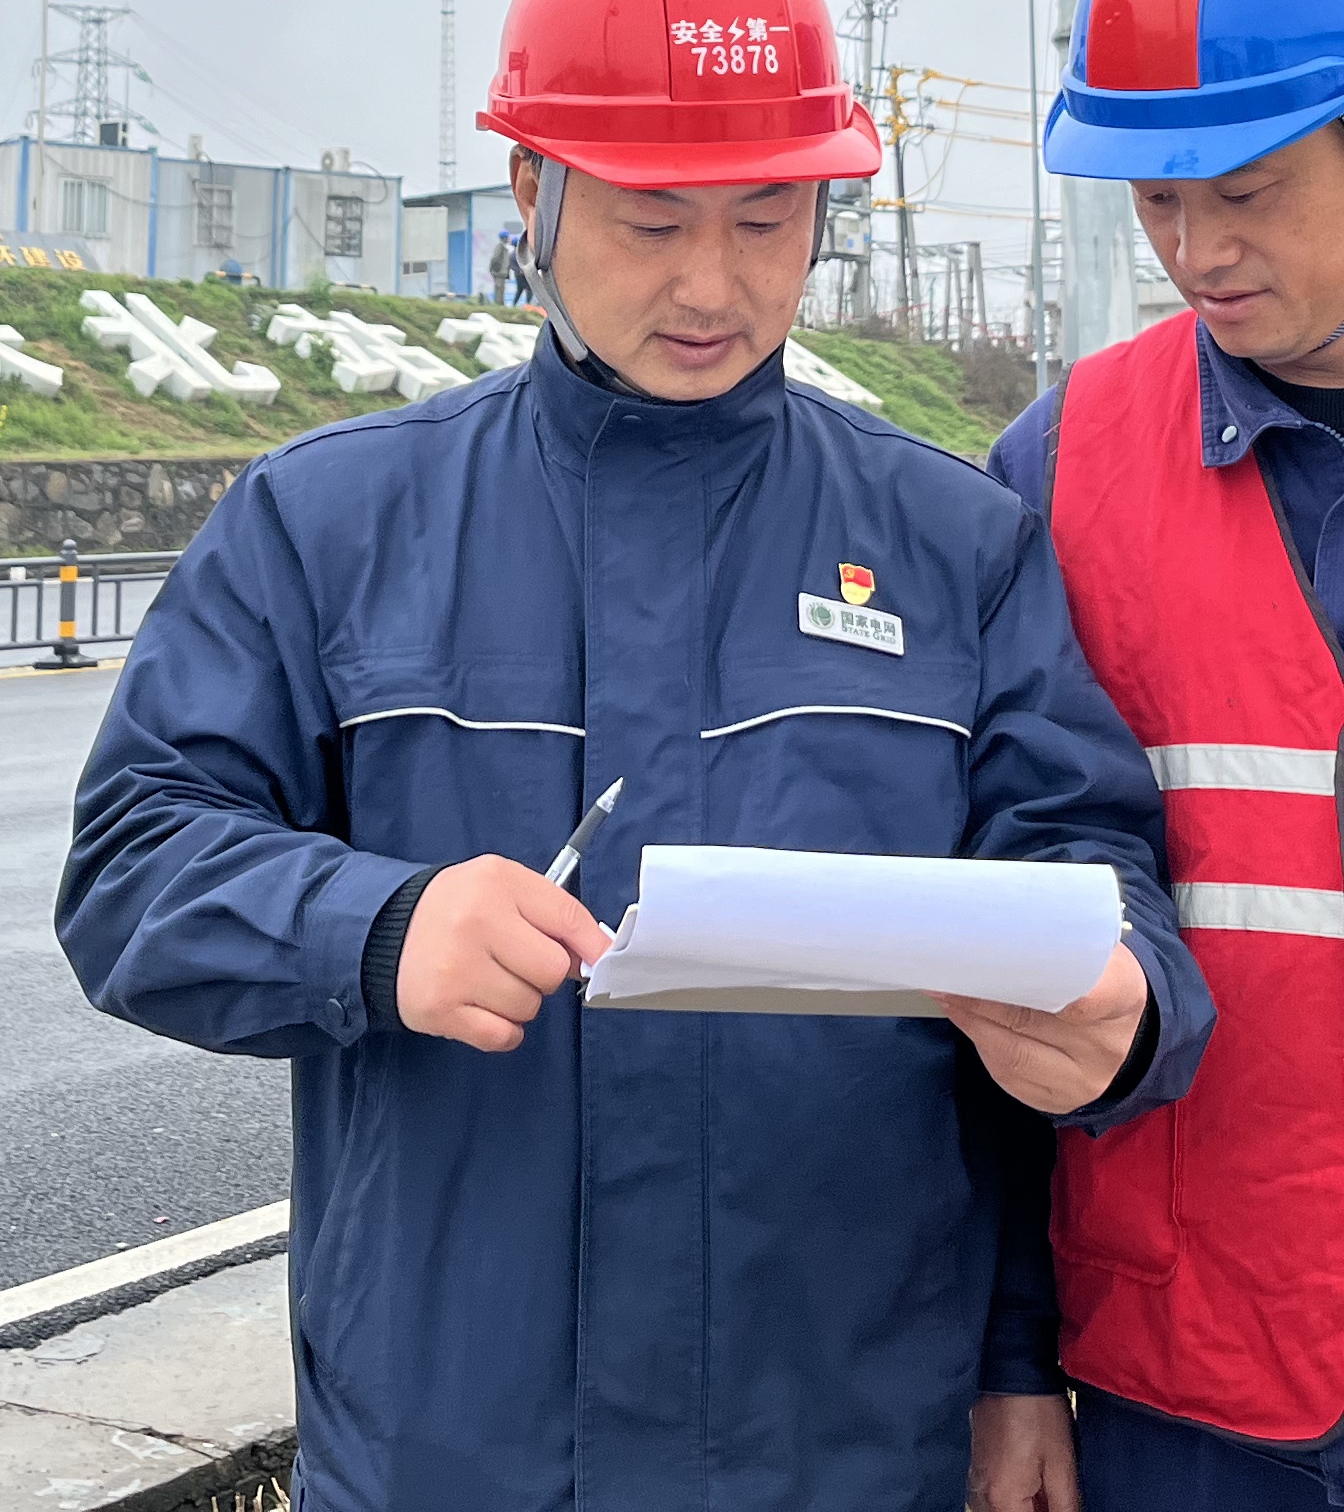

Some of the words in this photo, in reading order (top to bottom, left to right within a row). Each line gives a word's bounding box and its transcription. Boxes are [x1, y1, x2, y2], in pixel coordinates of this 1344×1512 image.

[670, 17, 790, 44] 安全第一
[691, 44, 778, 76] 73878
[841, 610, 896, 637] 国家电网
